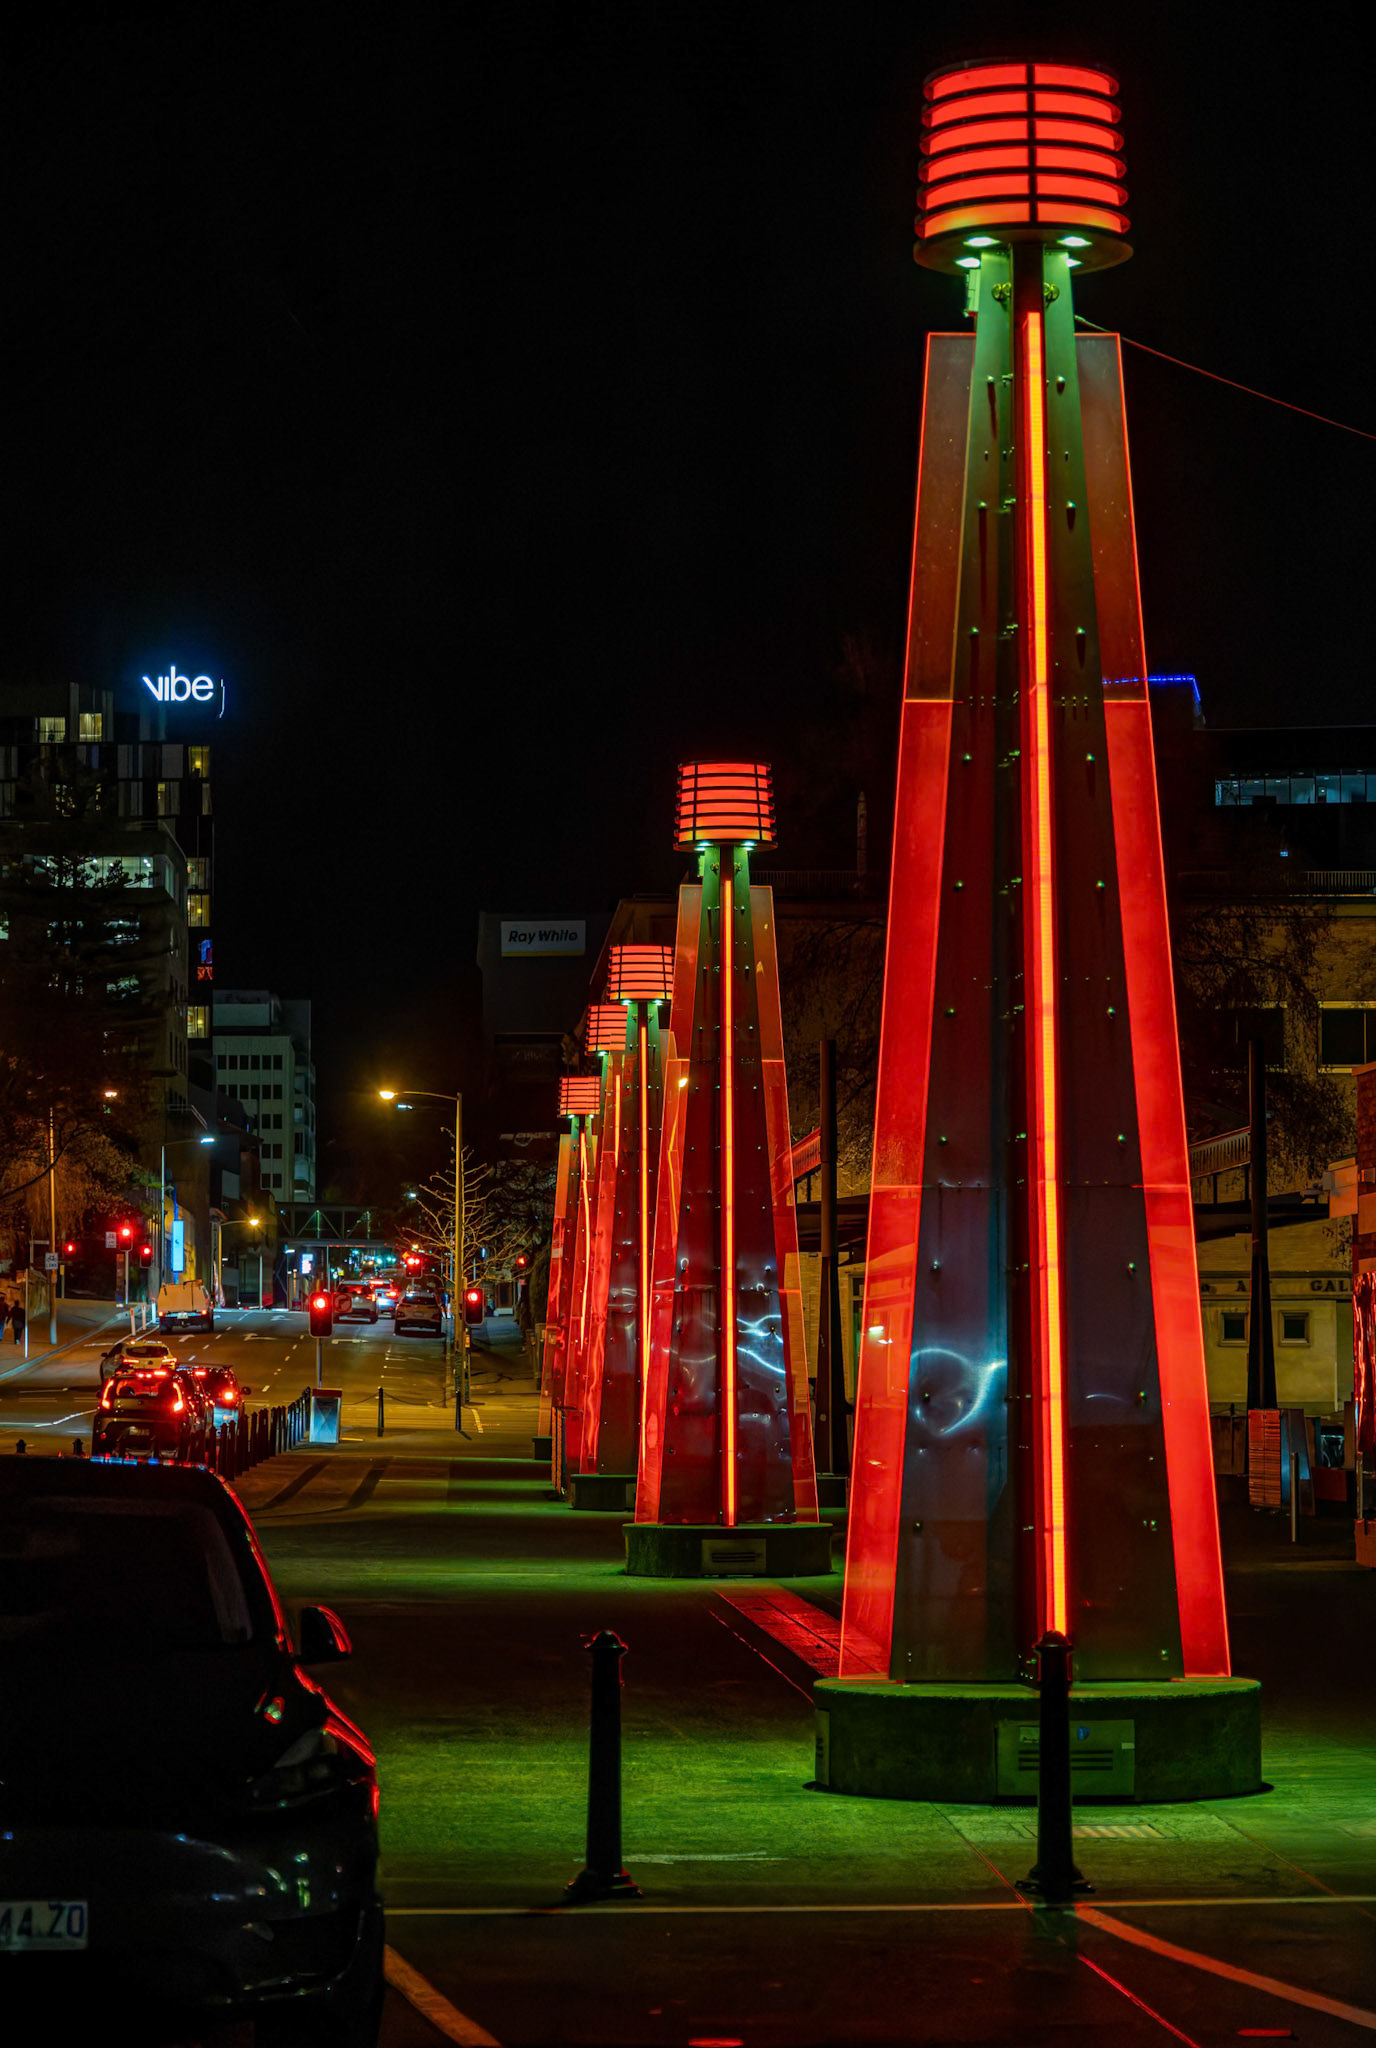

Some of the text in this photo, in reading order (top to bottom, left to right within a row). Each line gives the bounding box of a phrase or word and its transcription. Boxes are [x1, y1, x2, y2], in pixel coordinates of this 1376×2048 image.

[142, 665, 214, 702] vibe
[508, 929, 578, 944] Ray White
[1310, 1280, 1353, 1292] GAL
